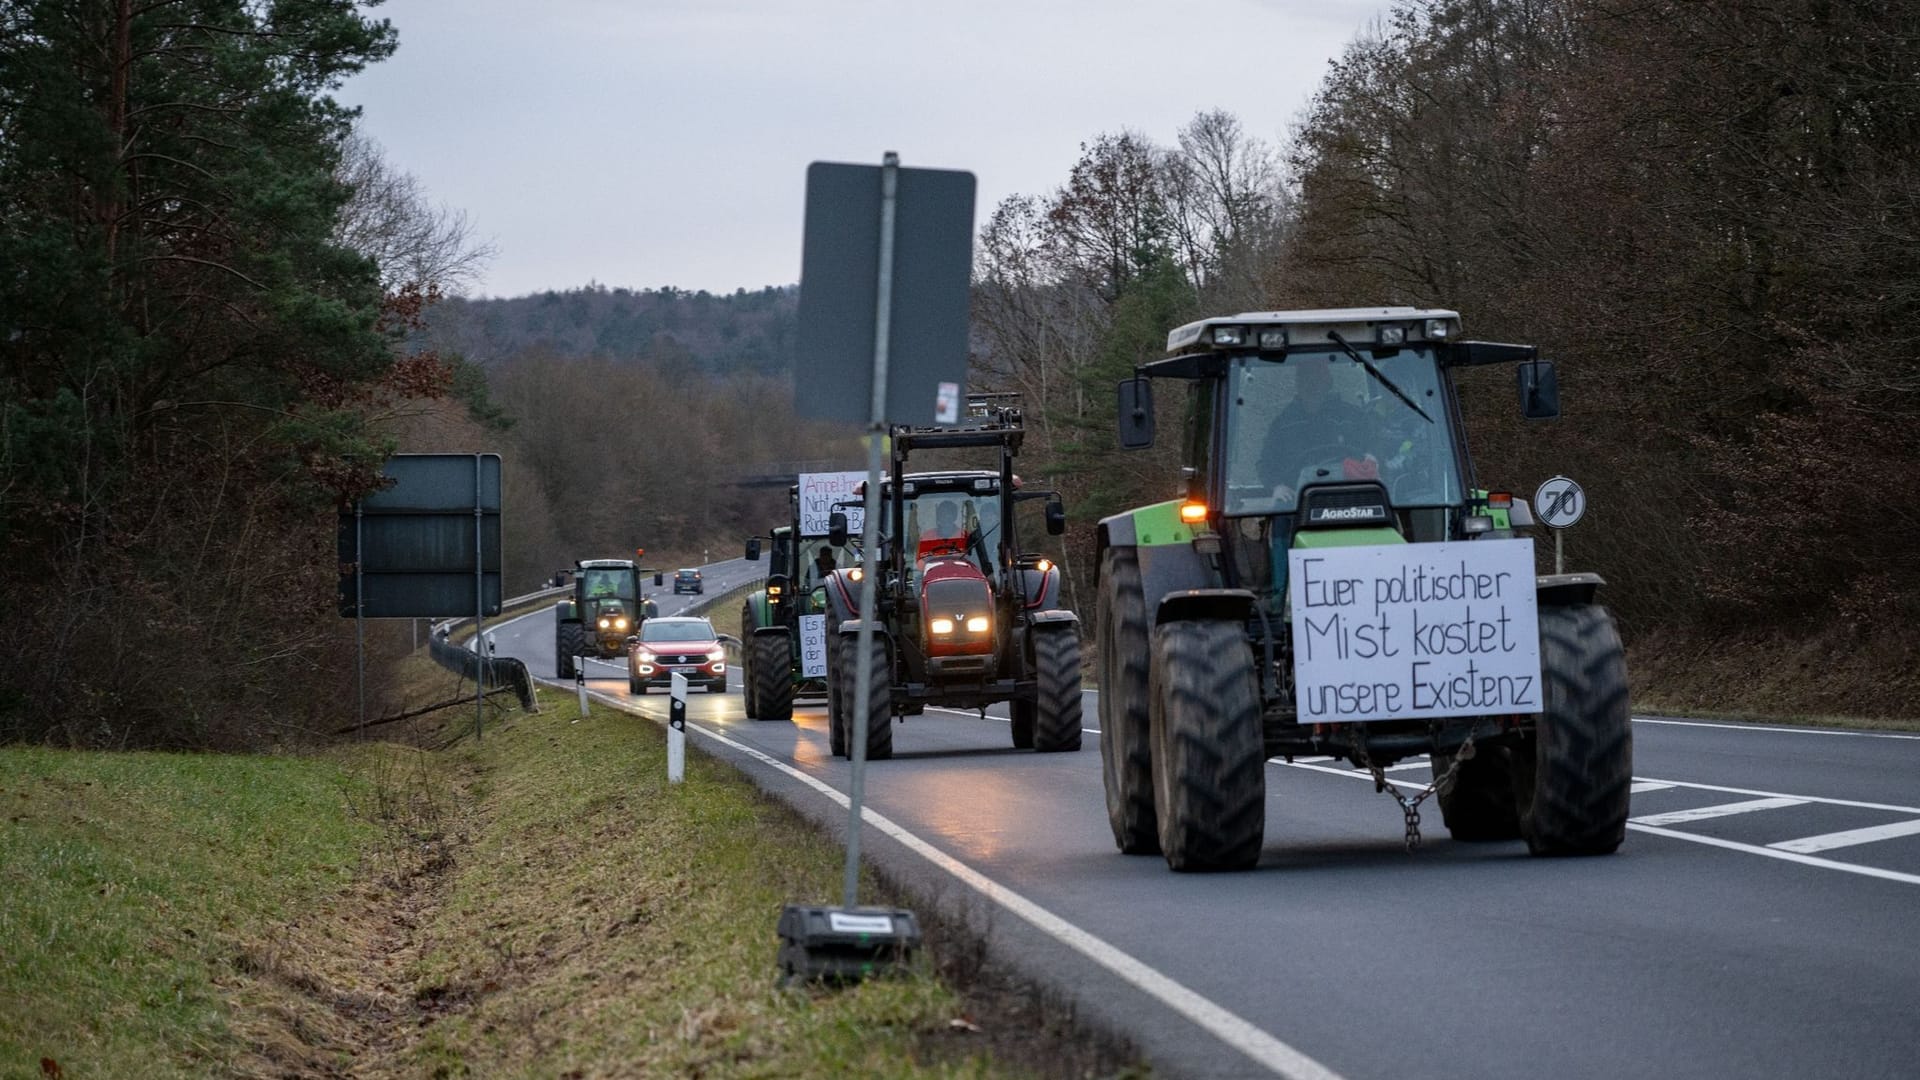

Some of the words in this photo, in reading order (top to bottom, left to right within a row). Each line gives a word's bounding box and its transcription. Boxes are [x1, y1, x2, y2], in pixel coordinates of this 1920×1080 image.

[1545, 491, 1576, 516] 70
[1303, 558, 1364, 608] Euer
[1375, 560, 1511, 617] politischer
[805, 616, 818, 631] Es
[805, 636, 817, 646] so
[1304, 612, 1399, 662] Mist
[1413, 605, 1516, 656] kostet
[1307, 681, 1402, 715] unsere
[1412, 659, 1533, 710] Existenz
